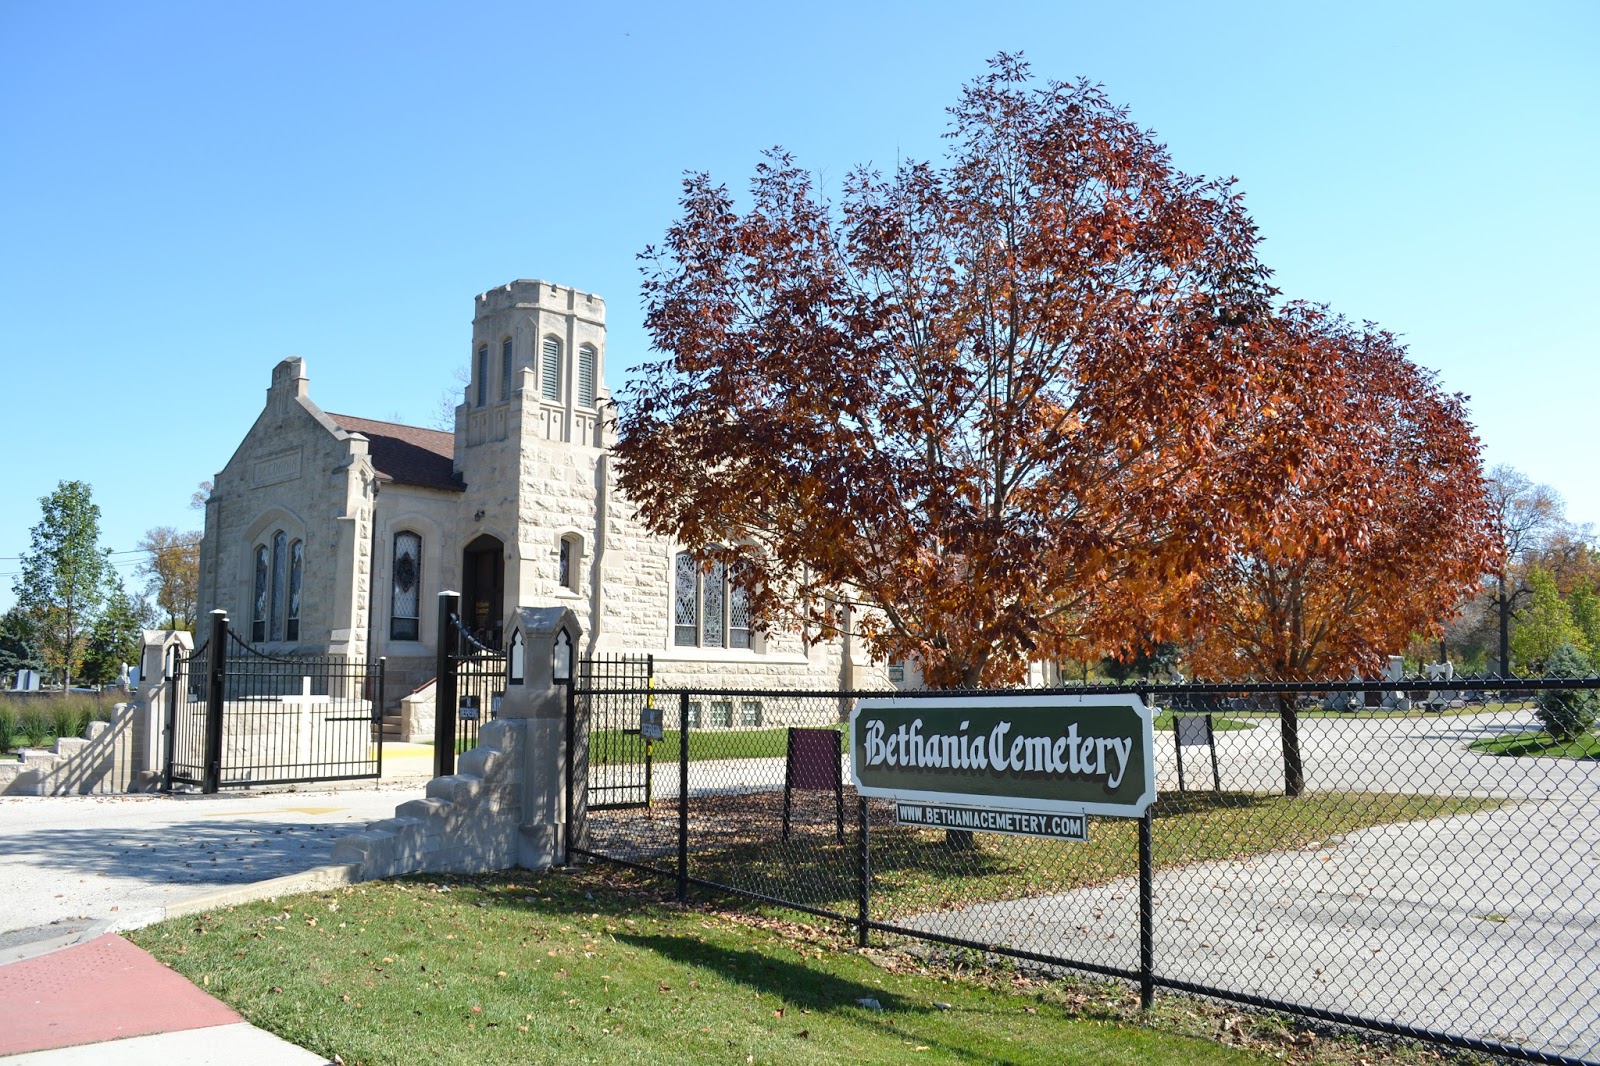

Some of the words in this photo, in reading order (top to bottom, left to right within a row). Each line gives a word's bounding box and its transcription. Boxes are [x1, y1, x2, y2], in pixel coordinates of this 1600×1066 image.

[864, 718, 988, 770] Bethania
[988, 720, 1132, 789] Cemetery
[899, 805, 1081, 835] WWW.BETHANIACEMETERY.COM
